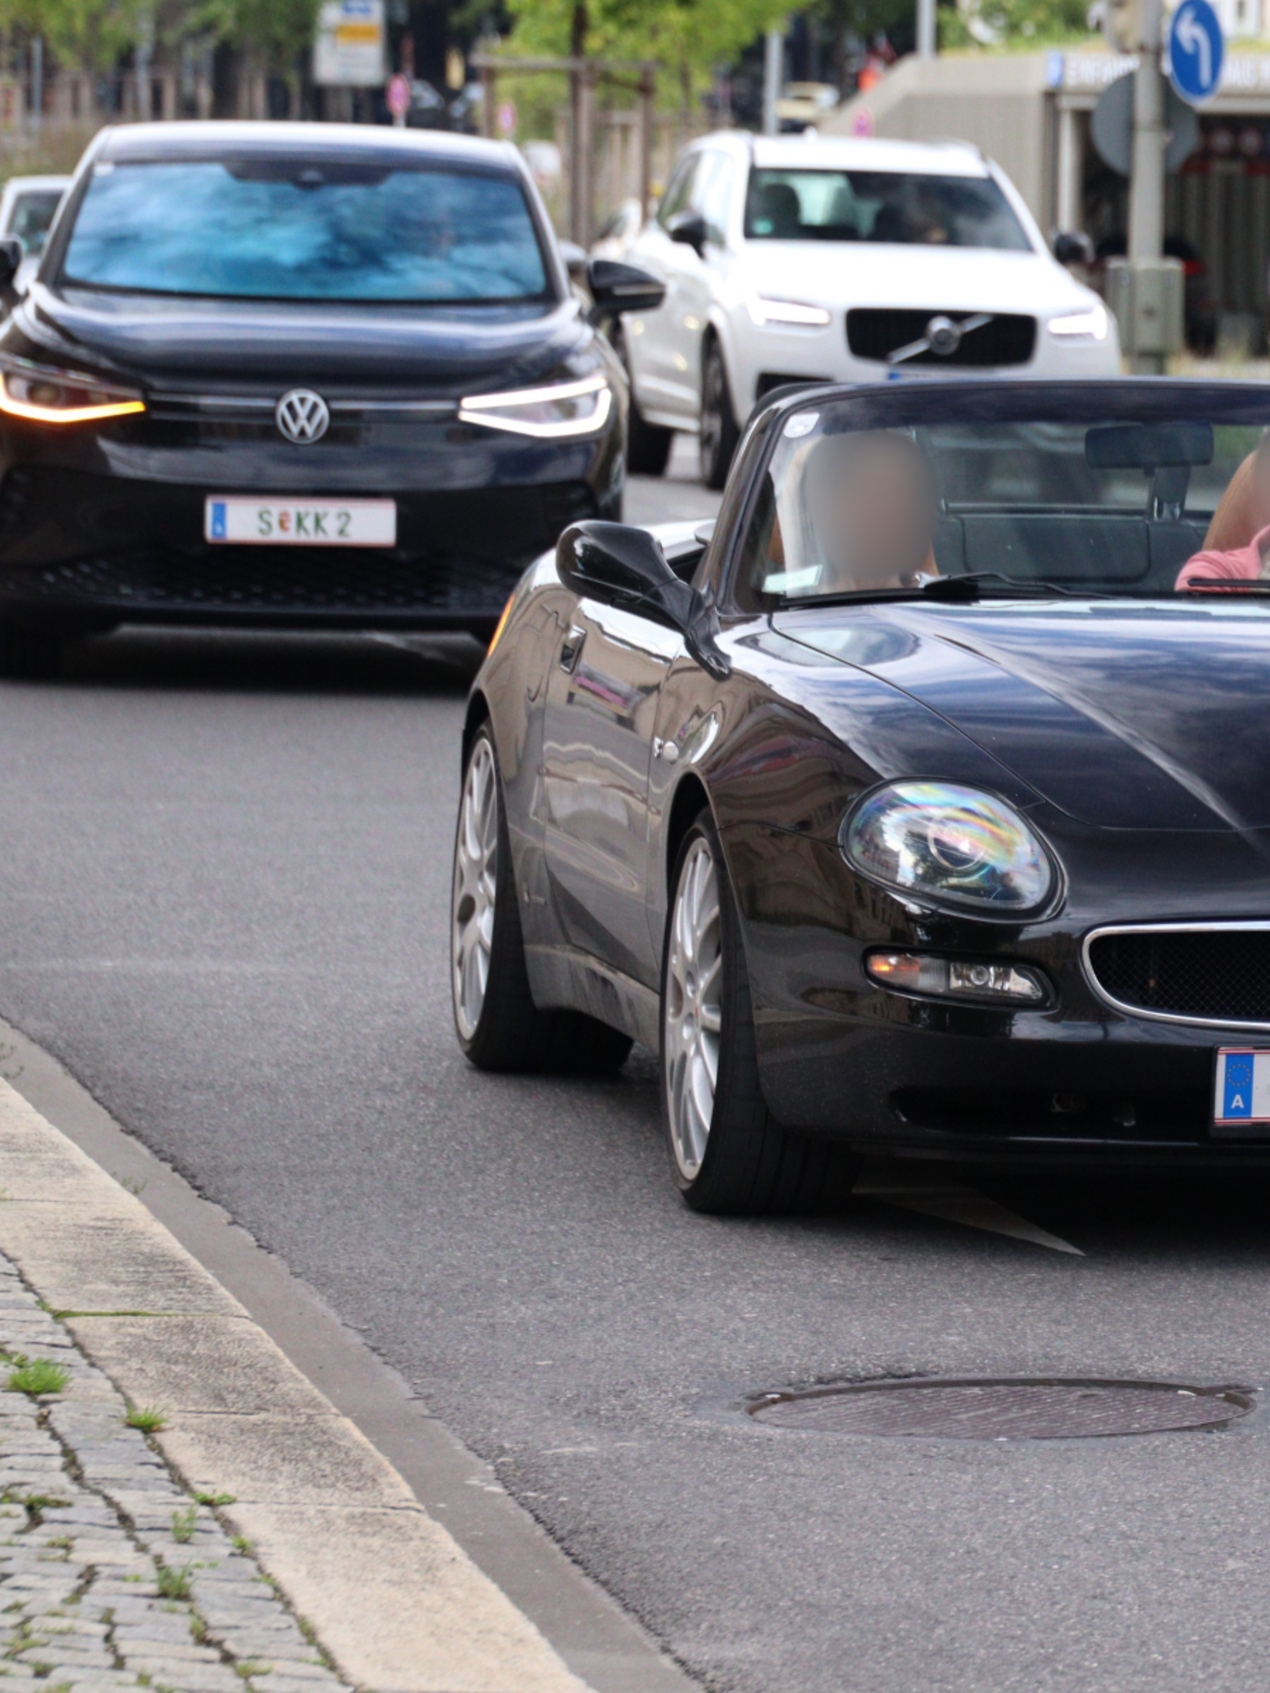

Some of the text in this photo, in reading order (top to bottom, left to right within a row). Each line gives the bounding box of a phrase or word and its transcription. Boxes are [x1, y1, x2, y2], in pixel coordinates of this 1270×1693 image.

[258, 510, 351, 537] S KK 2
[1231, 1094, 1244, 1109] A
